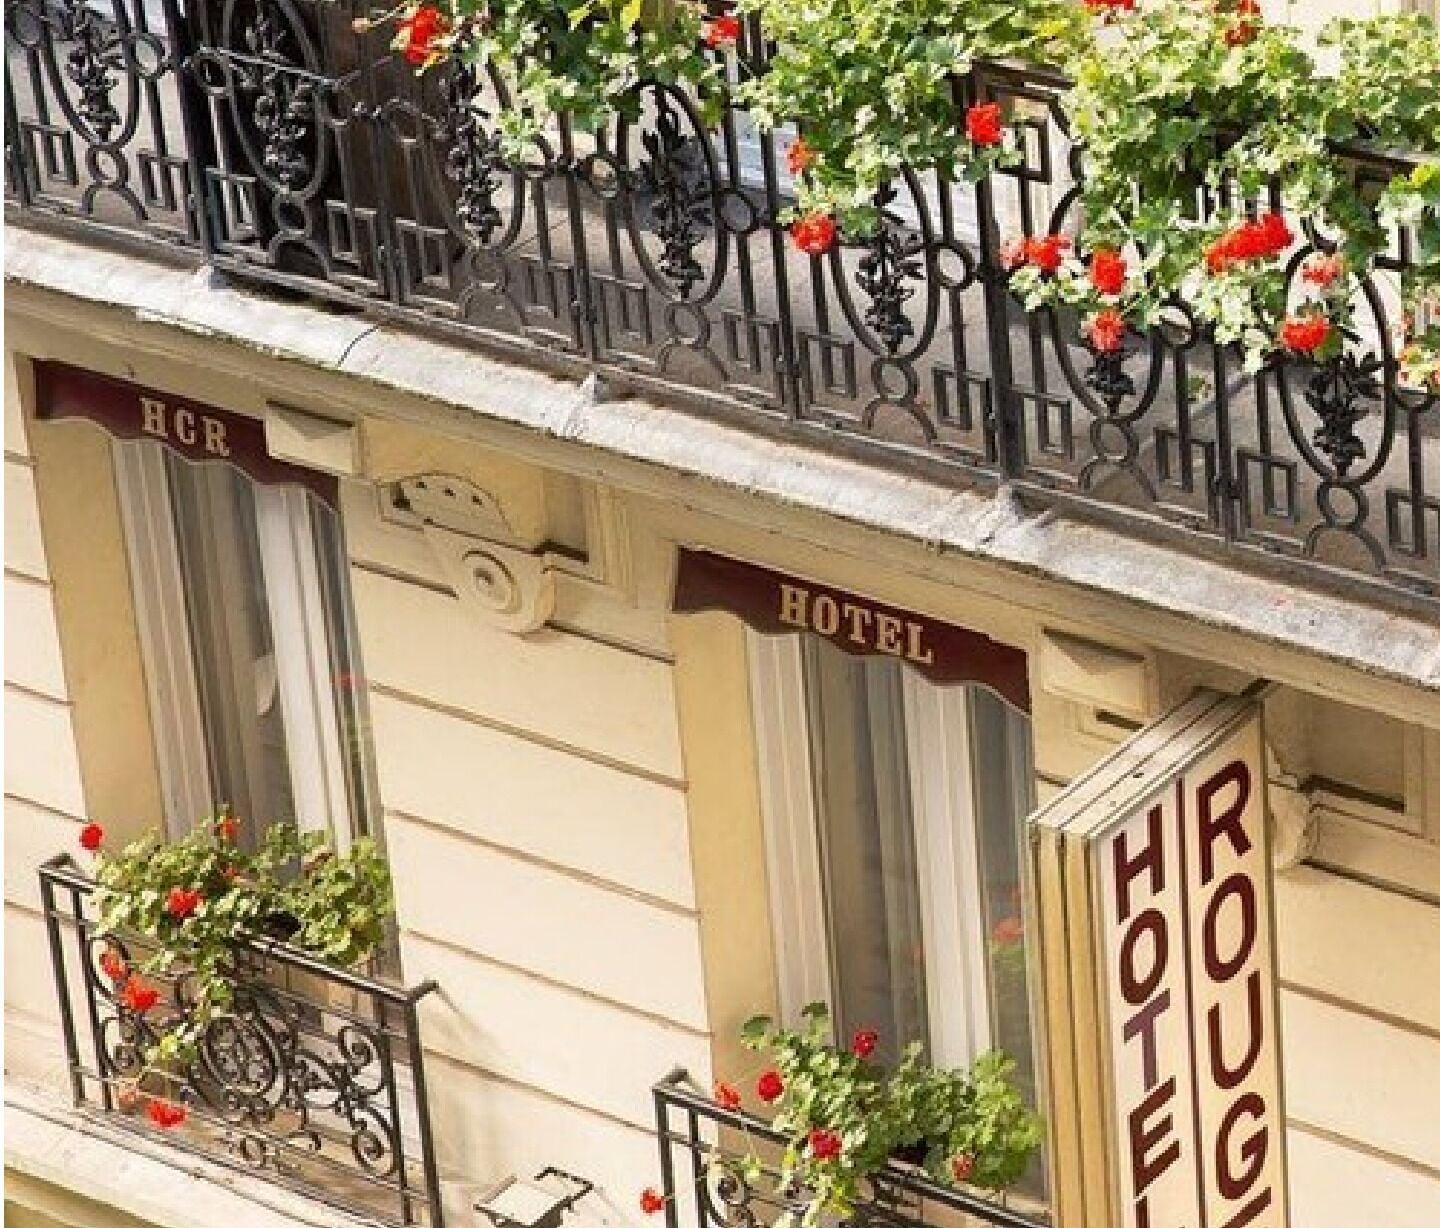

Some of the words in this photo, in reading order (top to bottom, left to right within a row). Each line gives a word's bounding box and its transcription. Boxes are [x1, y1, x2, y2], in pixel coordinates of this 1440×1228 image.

[138, 397, 230, 457] HCR
[778, 583, 934, 664] HOTEL
[1197, 759, 1272, 1228] ROUG
